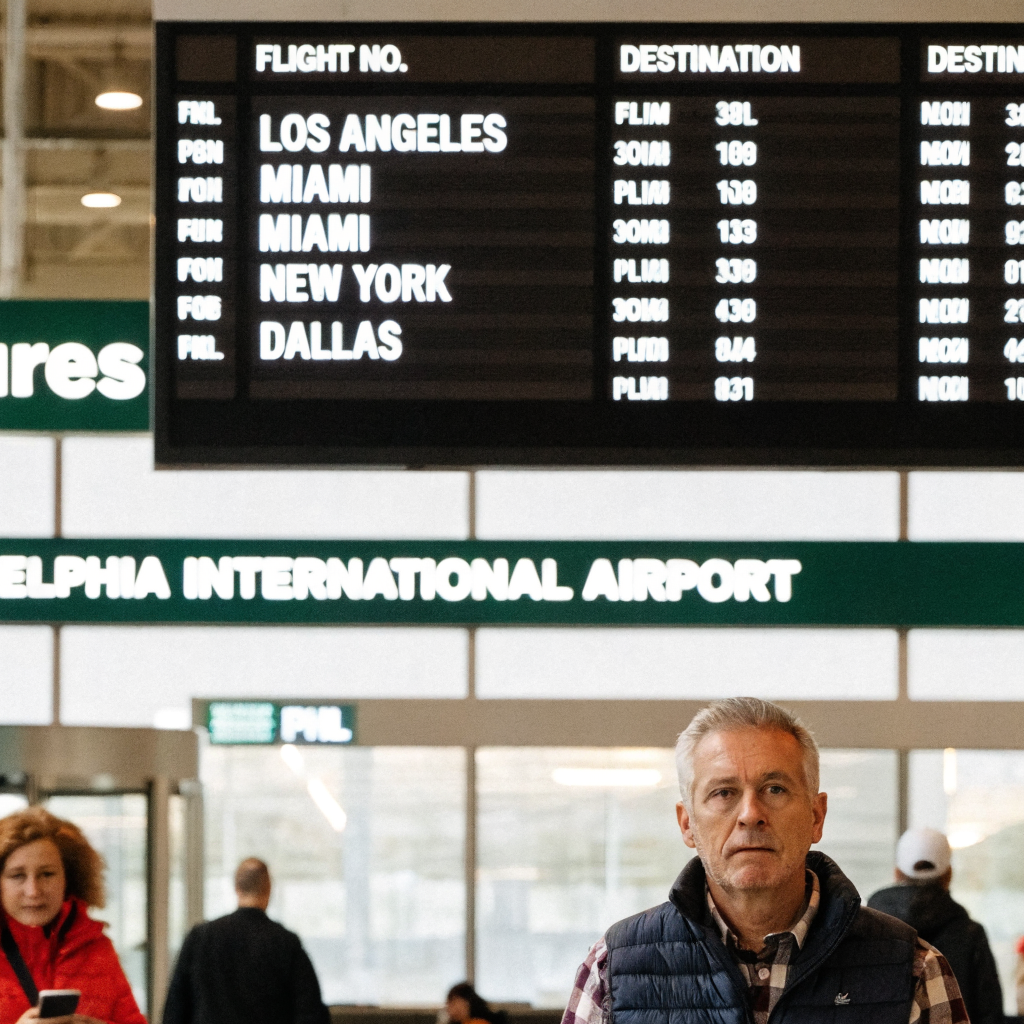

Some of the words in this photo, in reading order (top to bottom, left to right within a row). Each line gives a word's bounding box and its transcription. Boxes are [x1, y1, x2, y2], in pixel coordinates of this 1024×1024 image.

[256, 44, 355, 72] FLIGHT
[360, 44, 408, 72] NO.
[620, 45, 800, 72] DESTINATION
[260, 113, 330, 152] LOS
[339, 113, 507, 152] ANGELES
[260, 164, 371, 203] MIAMI
[259, 213, 370, 252] MIAMI
[260, 263, 343, 302] NEW
[352, 263, 452, 303] YORK
[260, 320, 403, 361] DALLAS
[183, 556, 574, 601] INTERNATIONAL
[582, 558, 802, 602] AIRPORT
